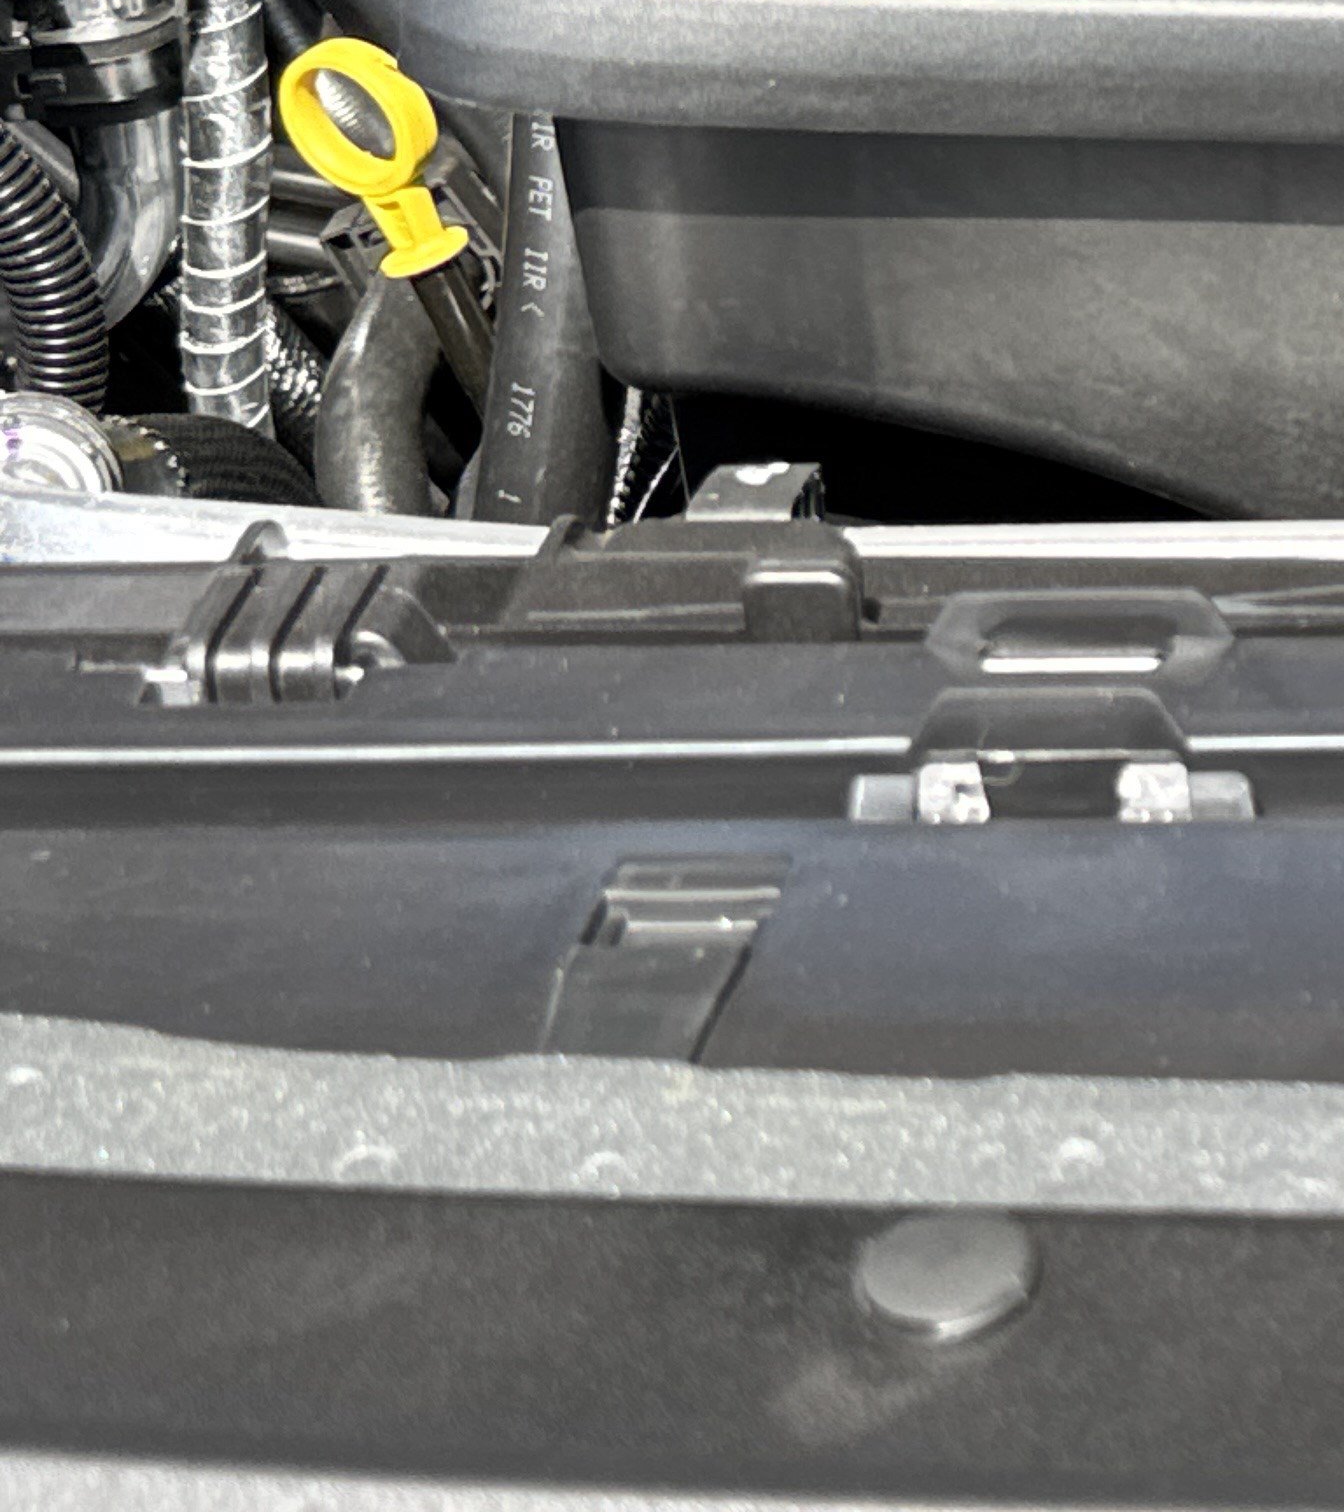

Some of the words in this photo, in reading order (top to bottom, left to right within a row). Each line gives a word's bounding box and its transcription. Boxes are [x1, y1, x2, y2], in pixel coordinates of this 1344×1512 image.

[531, 117, 556, 153] IR
[528, 175, 554, 222] PET
[507, 382, 536, 439] 1776
